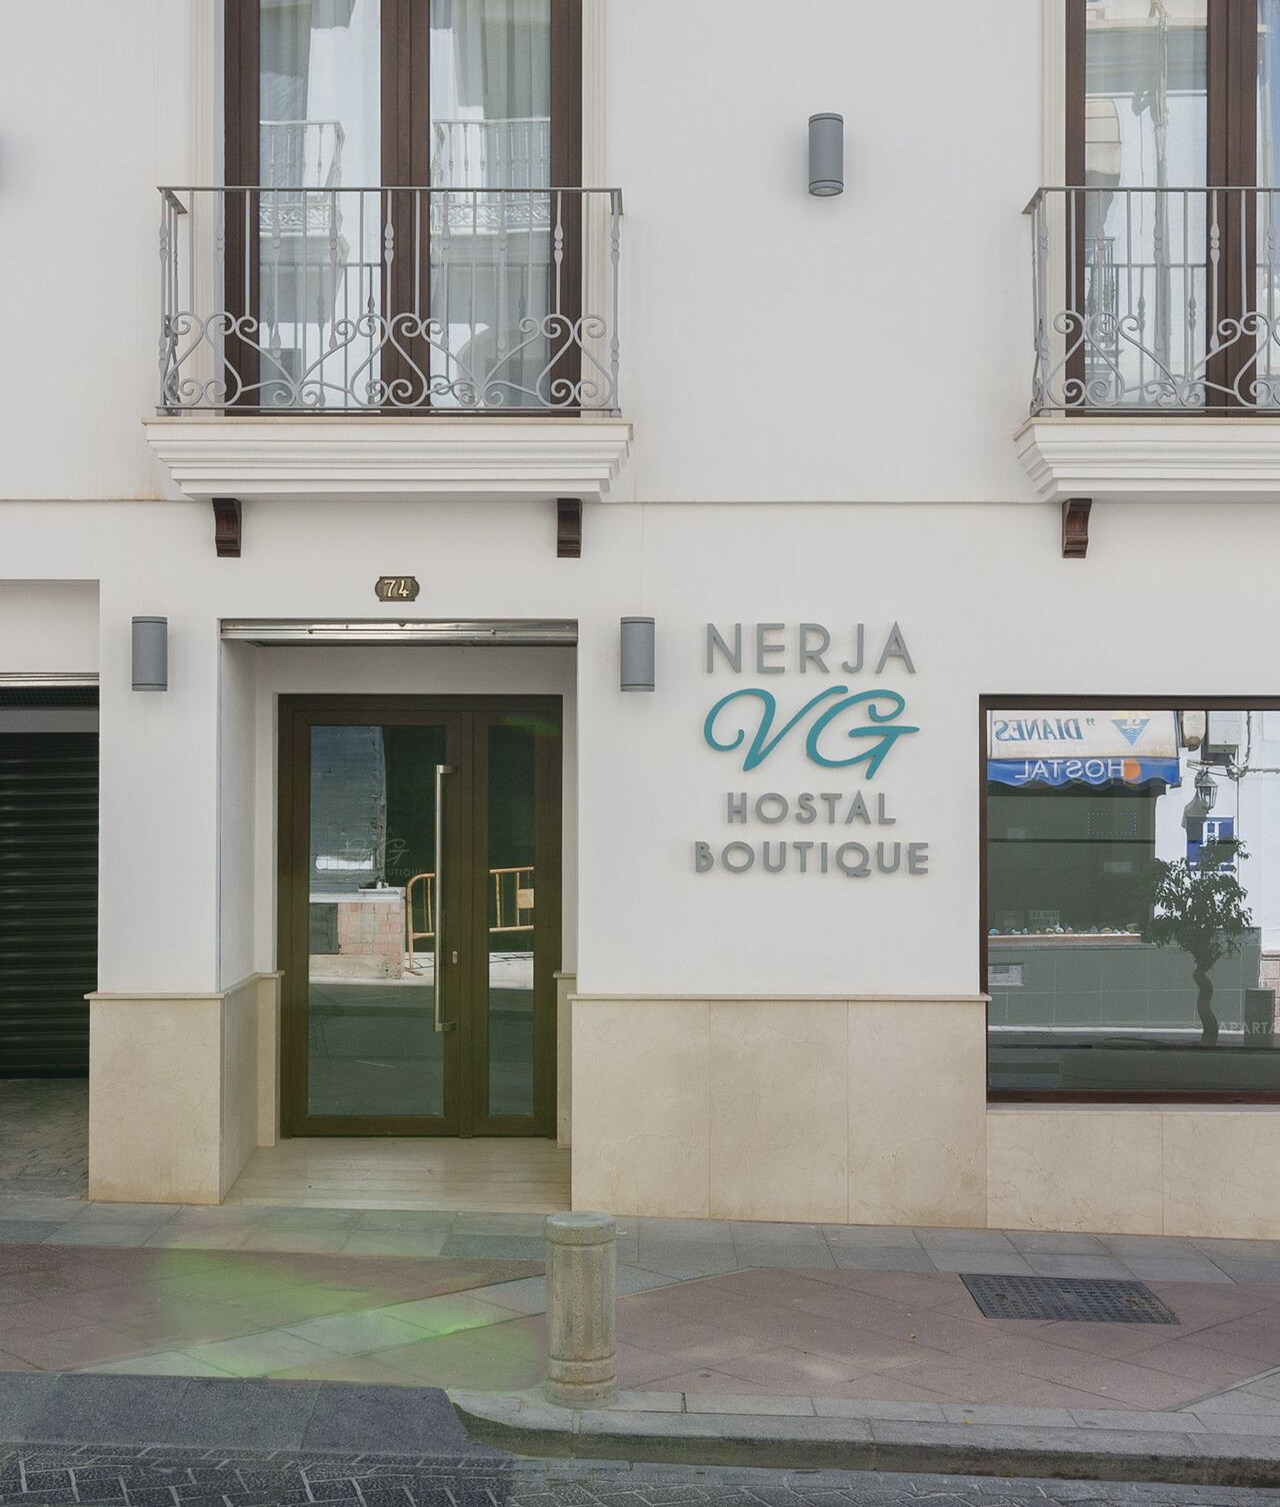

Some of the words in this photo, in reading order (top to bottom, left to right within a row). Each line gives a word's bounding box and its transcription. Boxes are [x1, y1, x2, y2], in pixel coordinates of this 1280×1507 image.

[384, 579, 410, 597] 74
[706, 620, 917, 675] NERJA
[703, 684, 920, 780] VG
[726, 790, 897, 825] HOSTAL
[693, 840, 929, 878] BOUTIQUE
